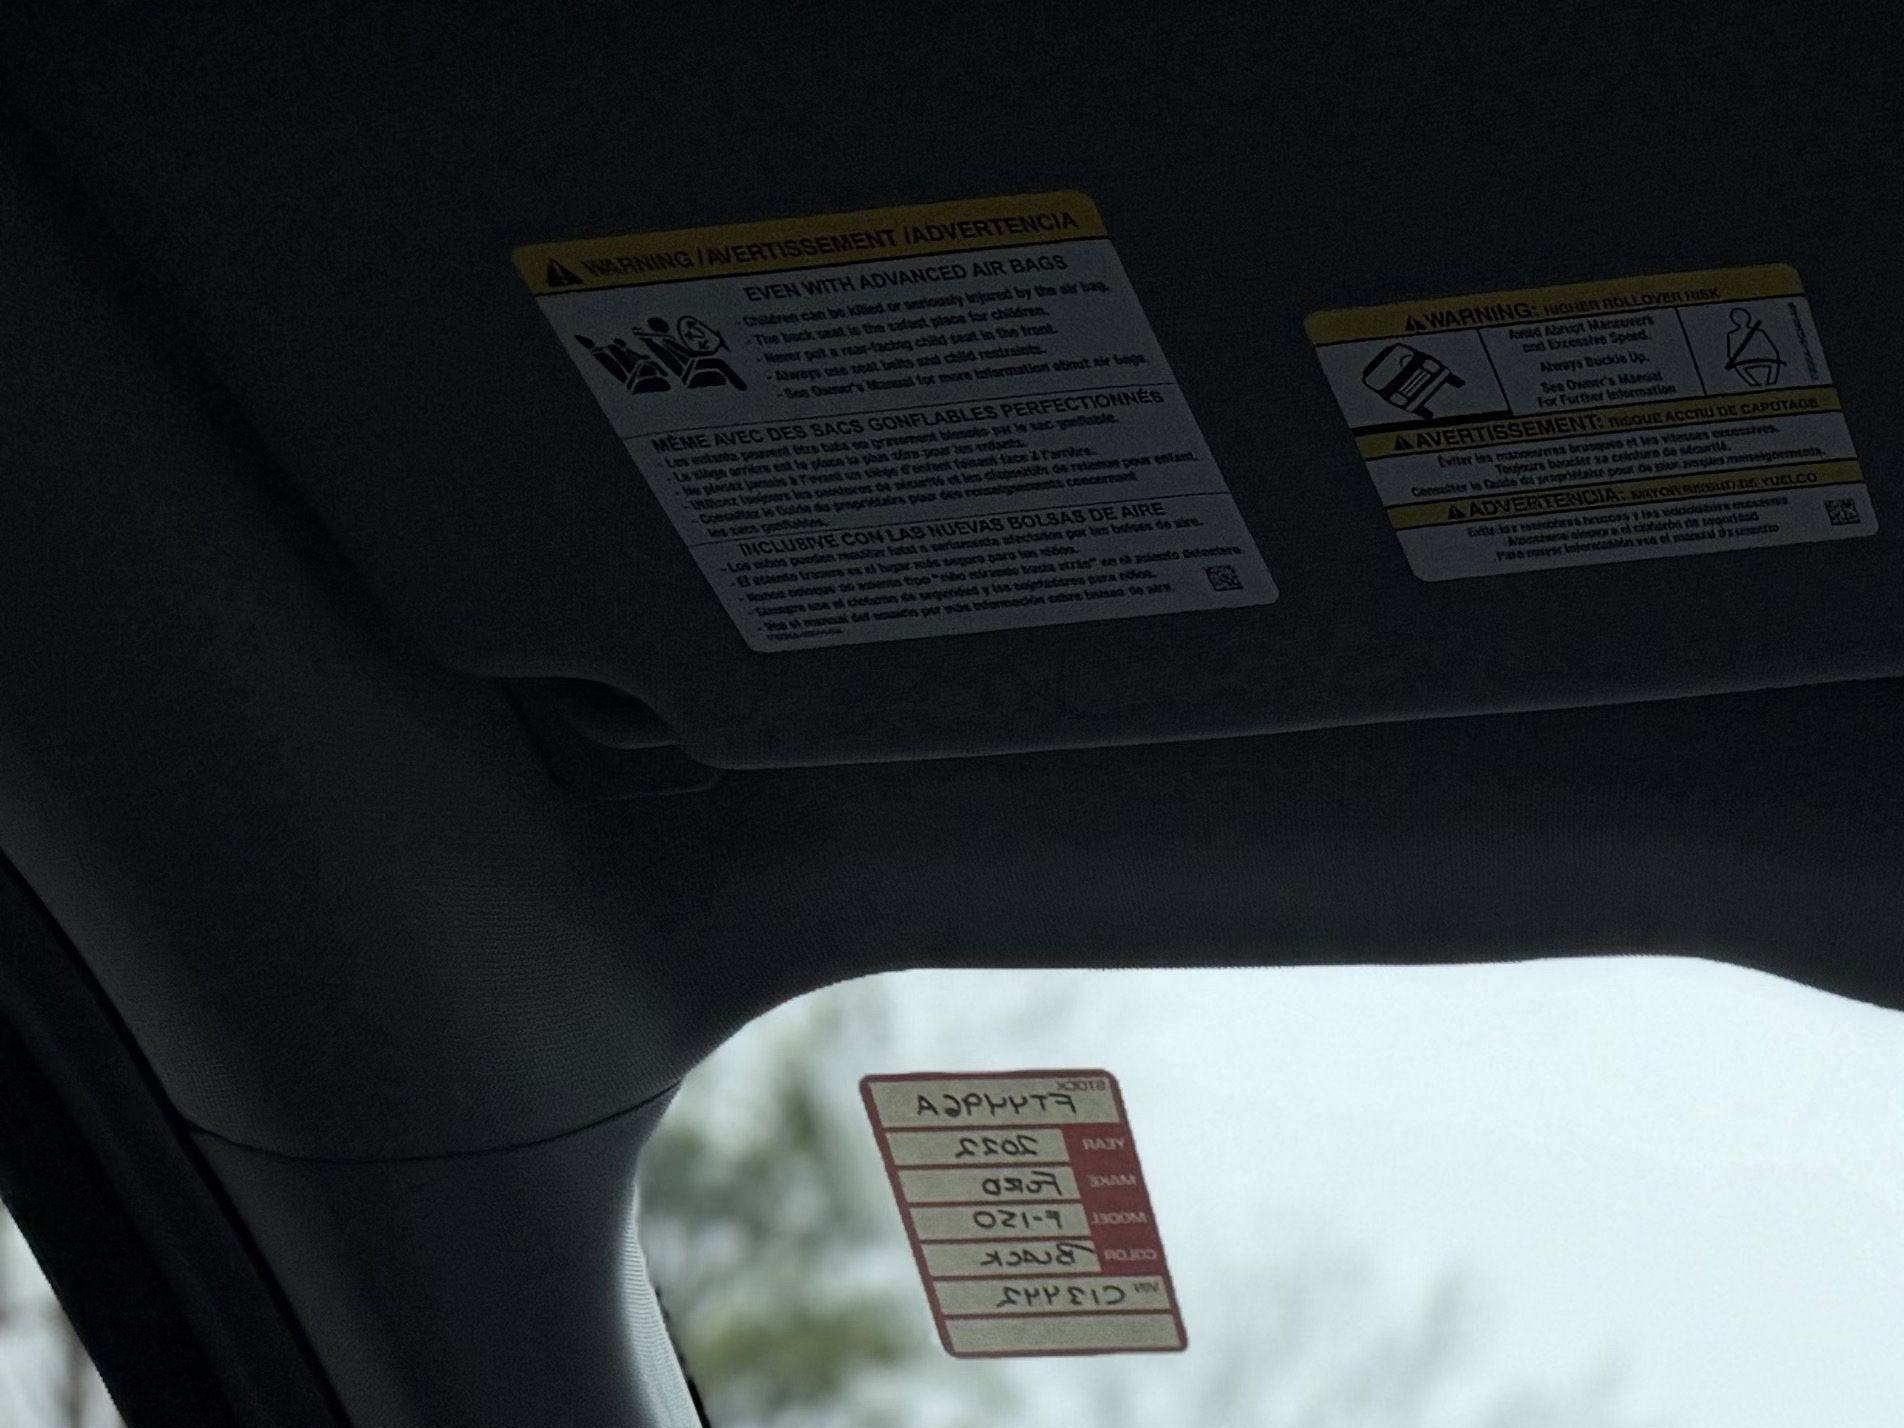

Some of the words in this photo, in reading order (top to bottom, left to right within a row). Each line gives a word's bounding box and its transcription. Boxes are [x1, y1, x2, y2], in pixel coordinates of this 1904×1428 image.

[581, 250, 693, 276] WARNING
[743, 283, 800, 301] EVEN
[801, 276, 855, 295] WITH
[859, 264, 966, 289] ADVANCED
[972, 260, 1006, 277] AIR
[1008, 254, 1067, 273] BAGS
[1423, 302, 1539, 327] WARNING:
[713, 428, 764, 446] AVEC
[765, 424, 807, 441] DES
[809, 418, 864, 437] SACS
[867, 405, 997, 431] GONFLABLES
[739, 534, 838, 556] INCLUSIVE
[885, 525, 926, 542] LAS
[927, 517, 1004, 536] NUEVAS
[1006, 509, 1086, 529] BOLSAS
[1087, 506, 1118, 522] DE
[1121, 501, 1165, 518] AIRE
